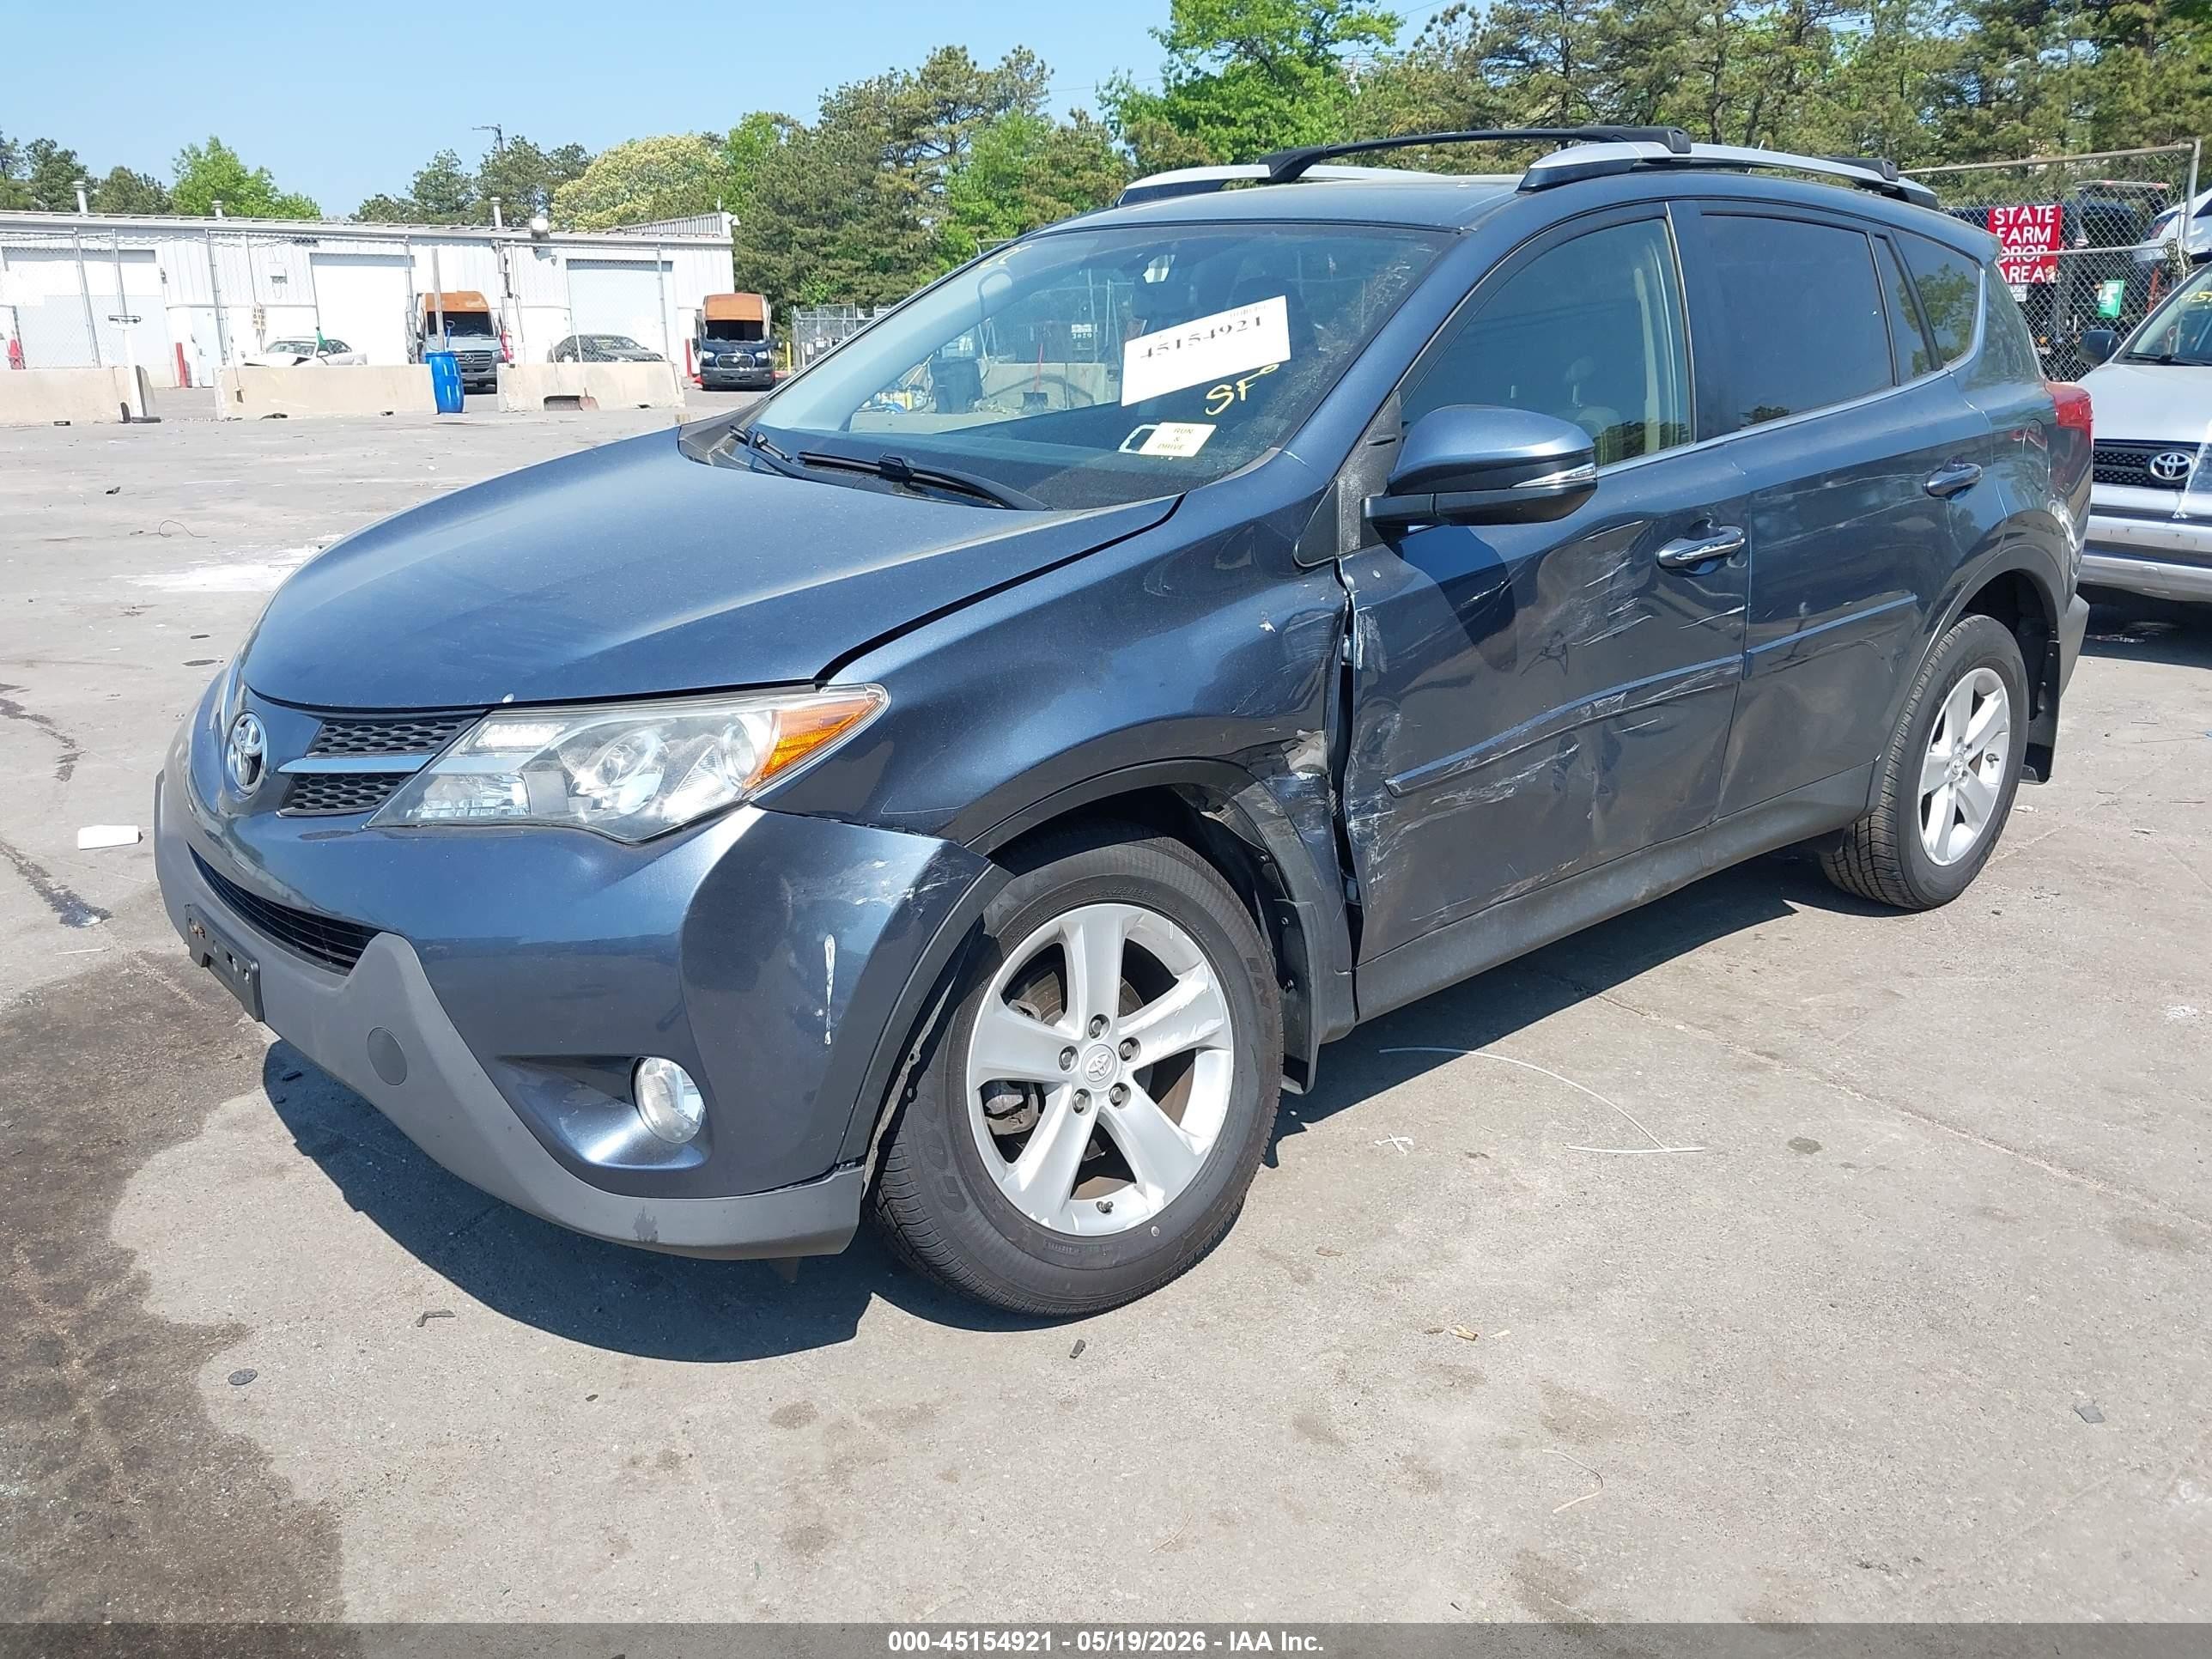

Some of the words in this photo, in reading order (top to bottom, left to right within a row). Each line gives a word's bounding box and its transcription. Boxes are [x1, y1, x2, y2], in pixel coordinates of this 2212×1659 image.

[1994, 205, 2056, 225] STATE
[1996, 225, 2051, 244] FARM
[1140, 316, 1261, 359] 45154921
